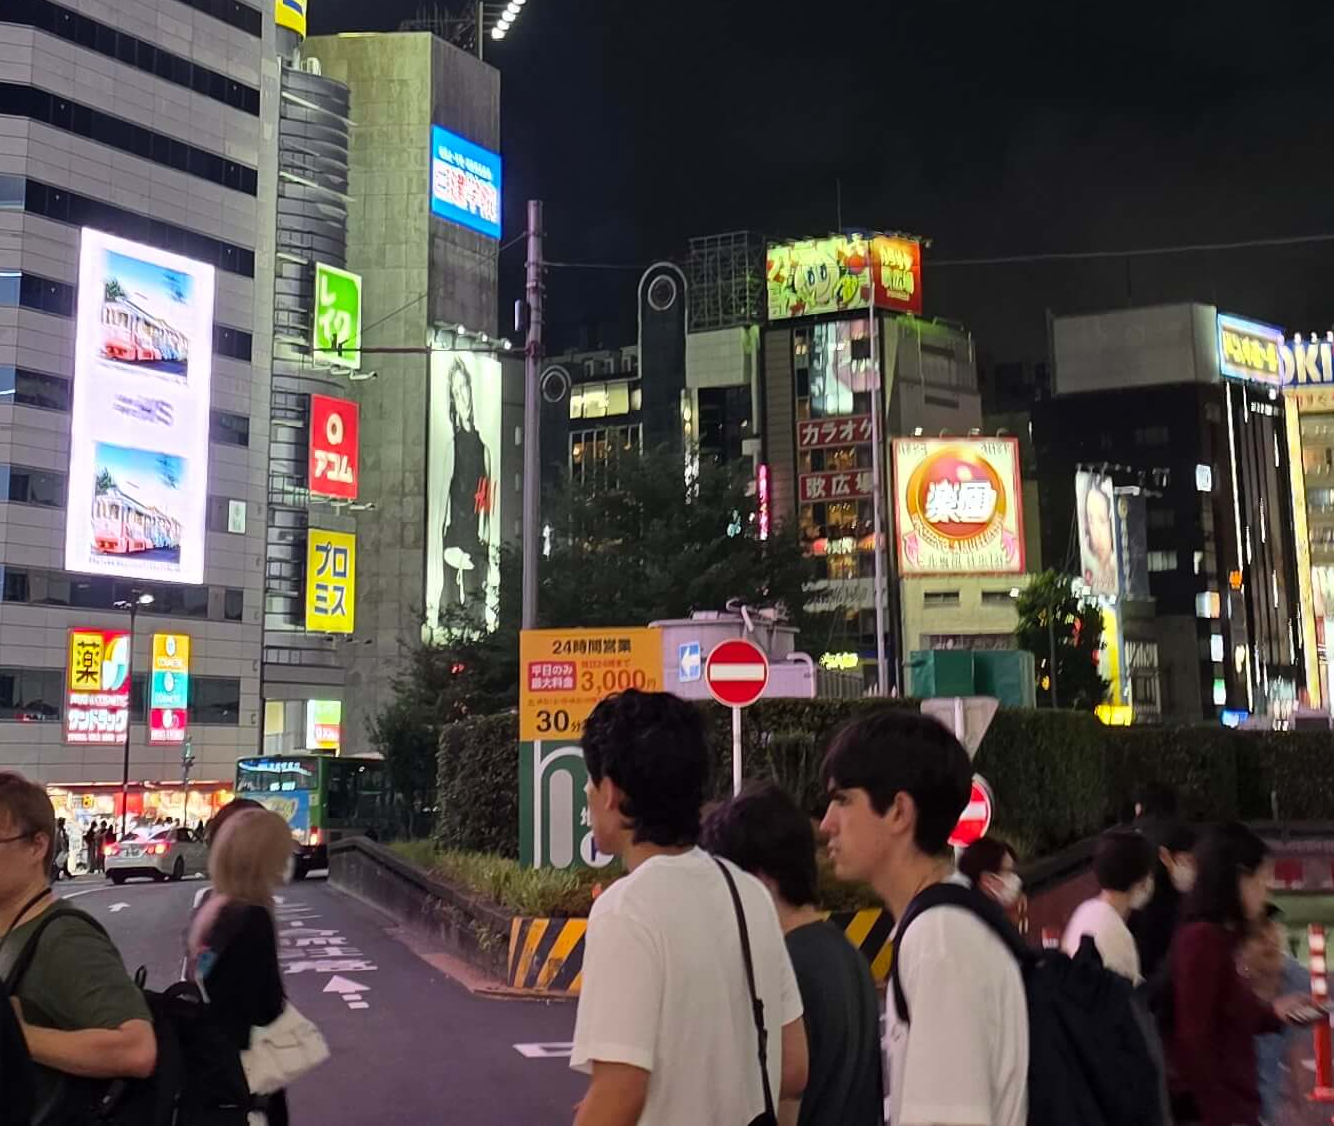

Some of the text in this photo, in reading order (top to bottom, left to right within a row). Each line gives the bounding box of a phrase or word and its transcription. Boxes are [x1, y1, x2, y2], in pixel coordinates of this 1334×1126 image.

[314, 449, 354, 484] アコム
[552, 638, 632, 655] 24時間営業
[75, 641, 100, 684] 薬
[531, 664, 573, 676] 平日のみ
